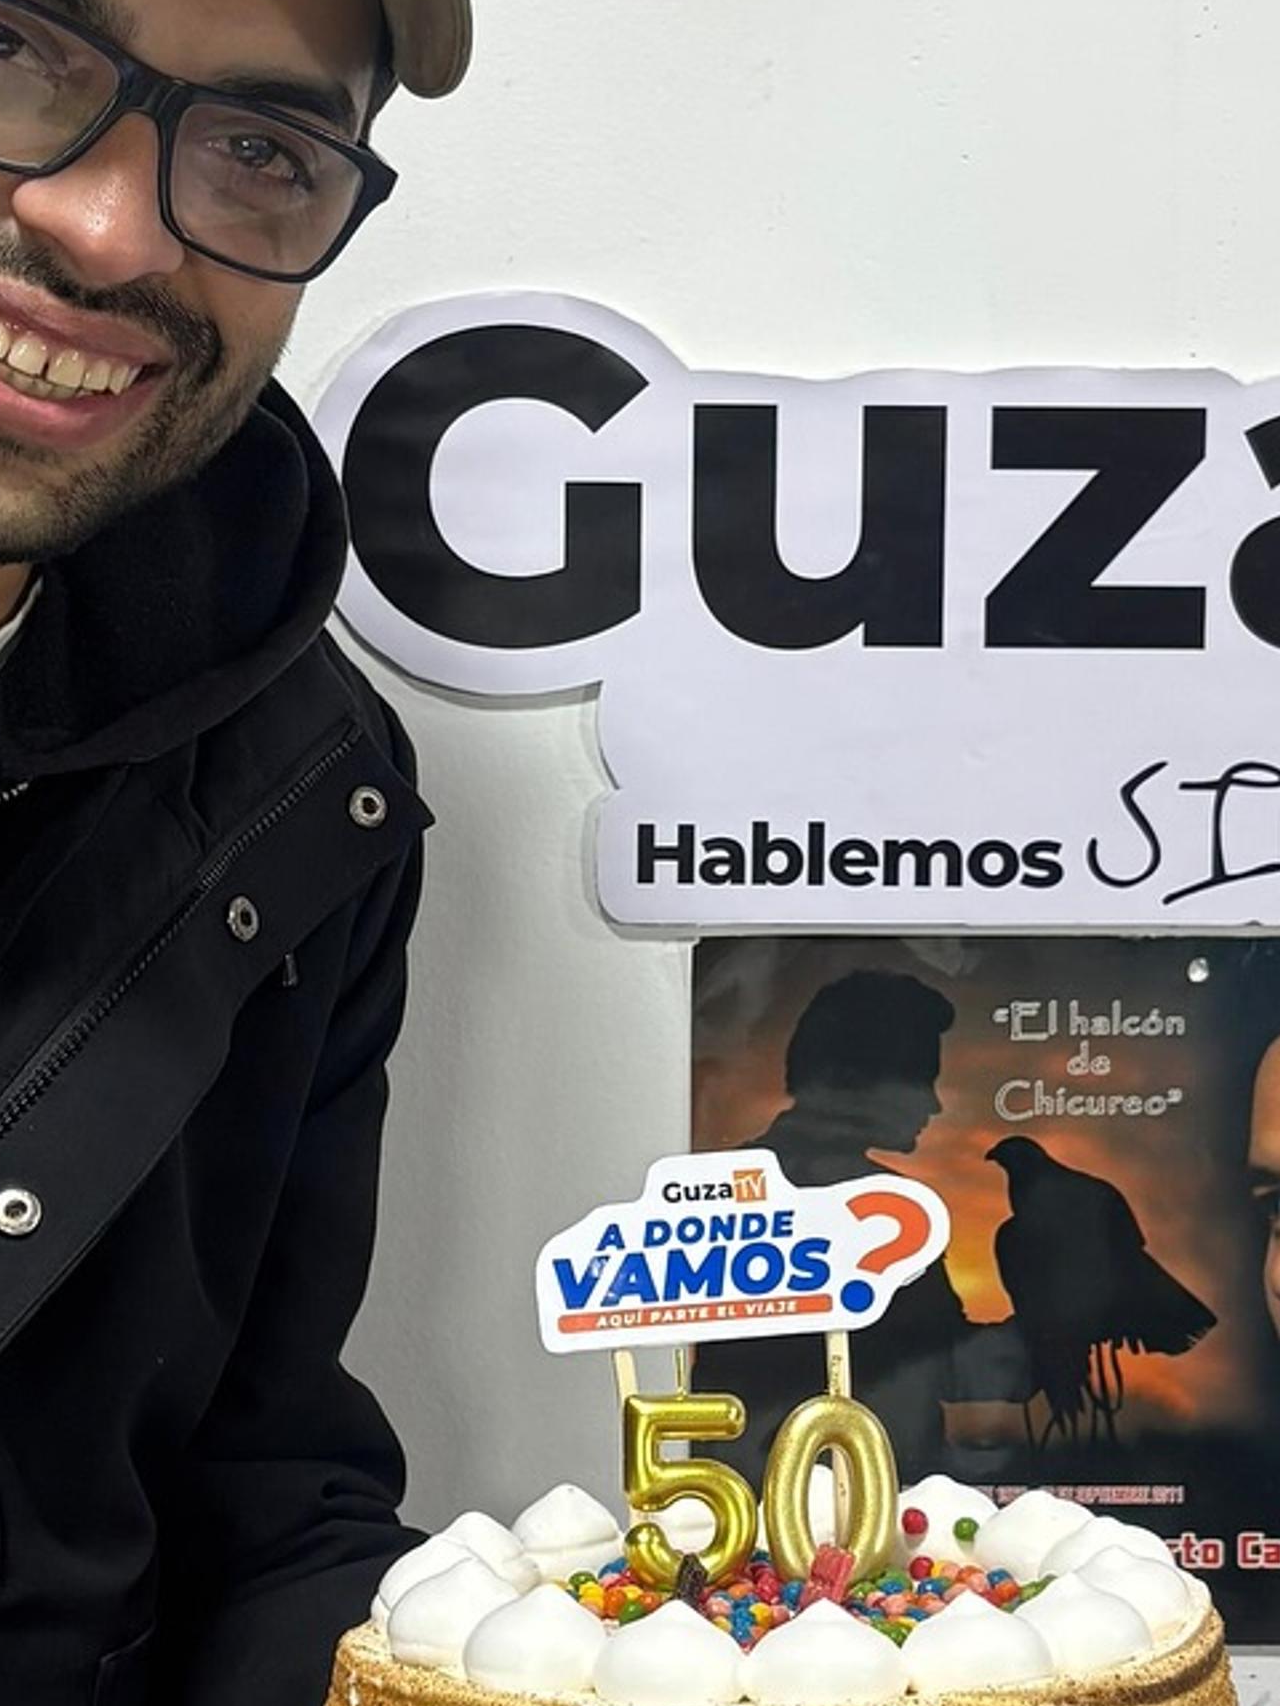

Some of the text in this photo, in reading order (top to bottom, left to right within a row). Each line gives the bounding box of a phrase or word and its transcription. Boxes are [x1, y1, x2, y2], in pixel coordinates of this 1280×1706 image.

[636, 821, 1065, 888] Hablemos
[1069, 999, 1186, 1036] halcón
[1066, 1040, 1111, 1076] de
[596, 1210, 796, 1252] A DONDE
[650, 1307, 709, 1324] PARTE
[716, 1304, 737, 1317] EL
[744, 1299, 798, 1315] VIAJE
[624, 1392, 899, 1599] 50
